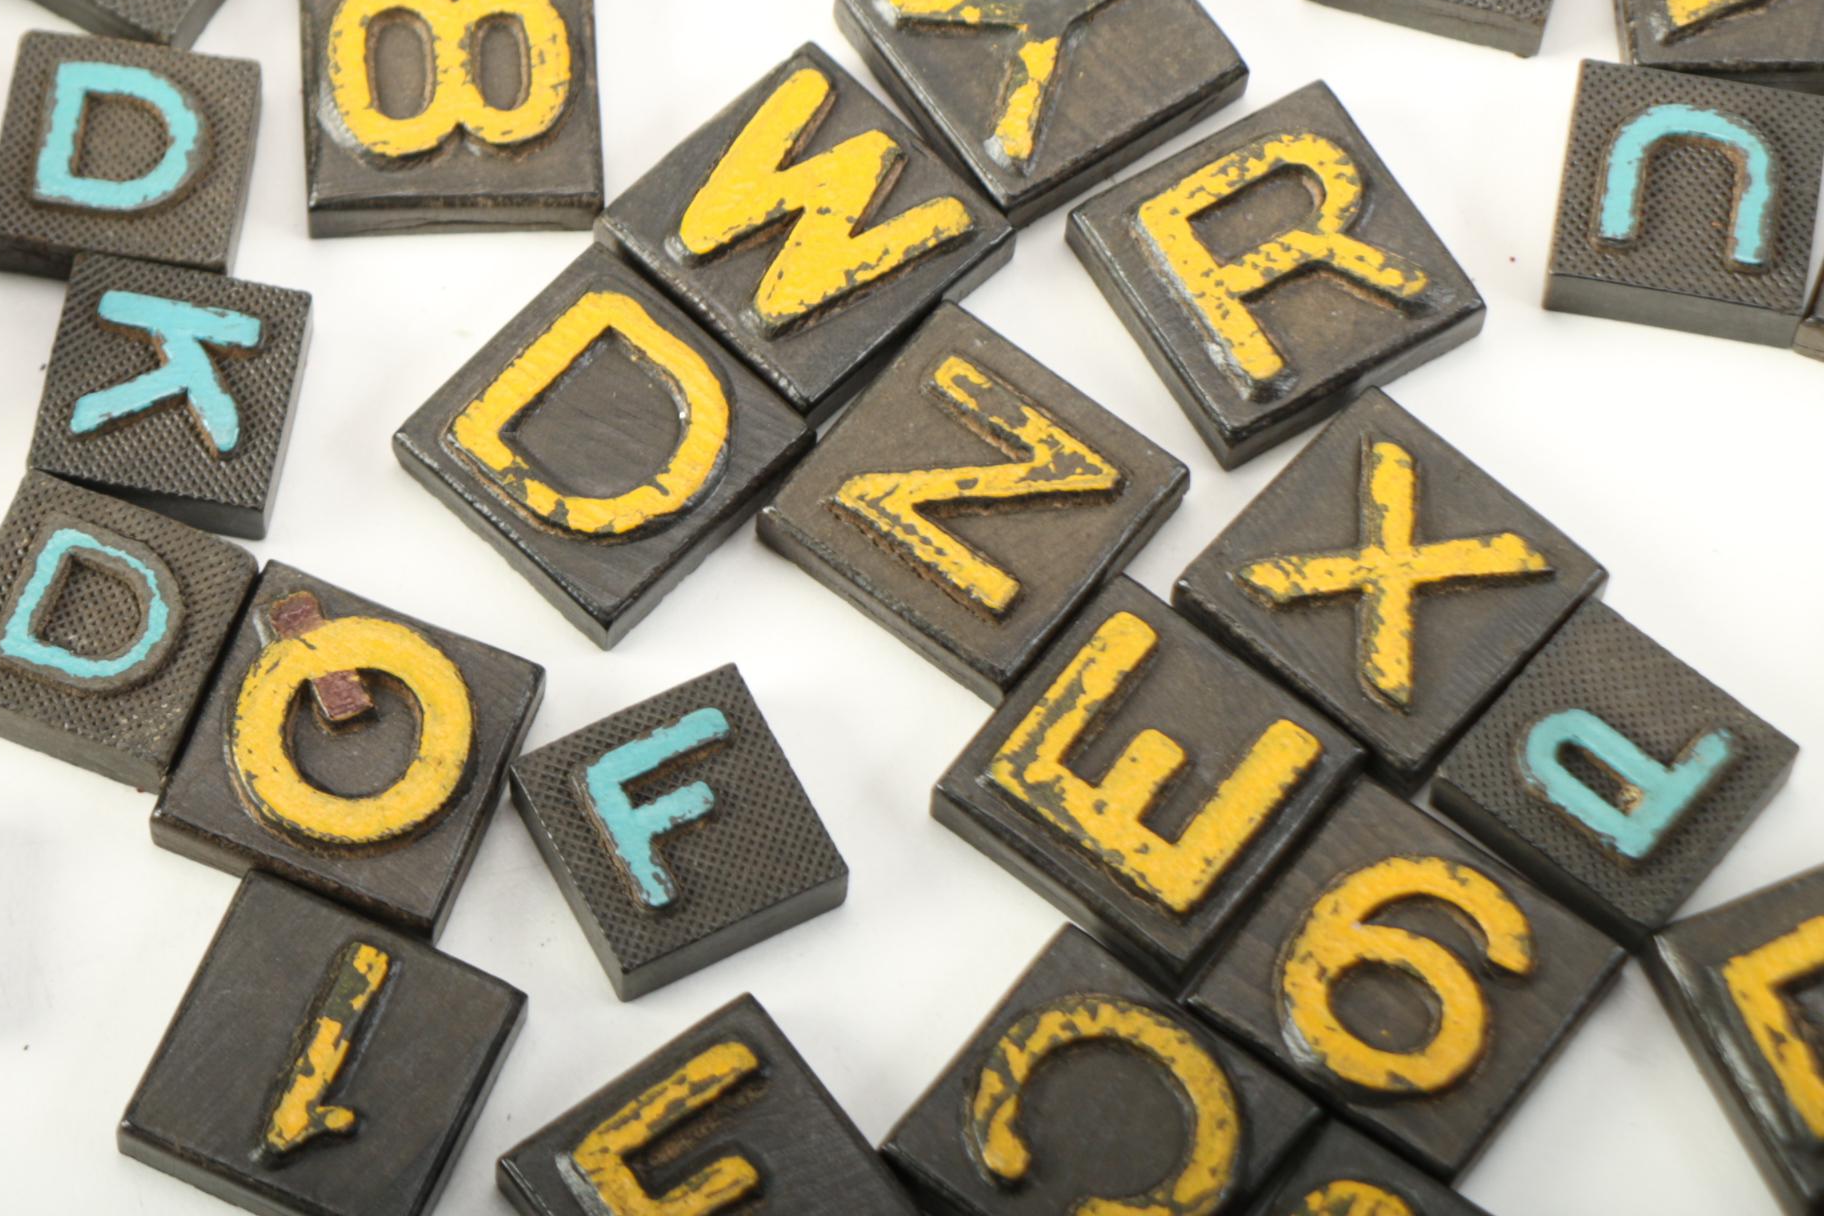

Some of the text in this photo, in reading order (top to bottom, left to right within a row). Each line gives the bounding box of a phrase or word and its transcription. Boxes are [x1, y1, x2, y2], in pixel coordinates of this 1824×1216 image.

[36, 63, 201, 208] D
[1138, 132, 1429, 384] R
[70, 291, 262, 452] K
[453, 291, 730, 534] D
[1238, 441, 1548, 702] X
[585, 706, 731, 906] F
[977, 610, 1322, 911] E
[1526, 710, 1732, 858] P
